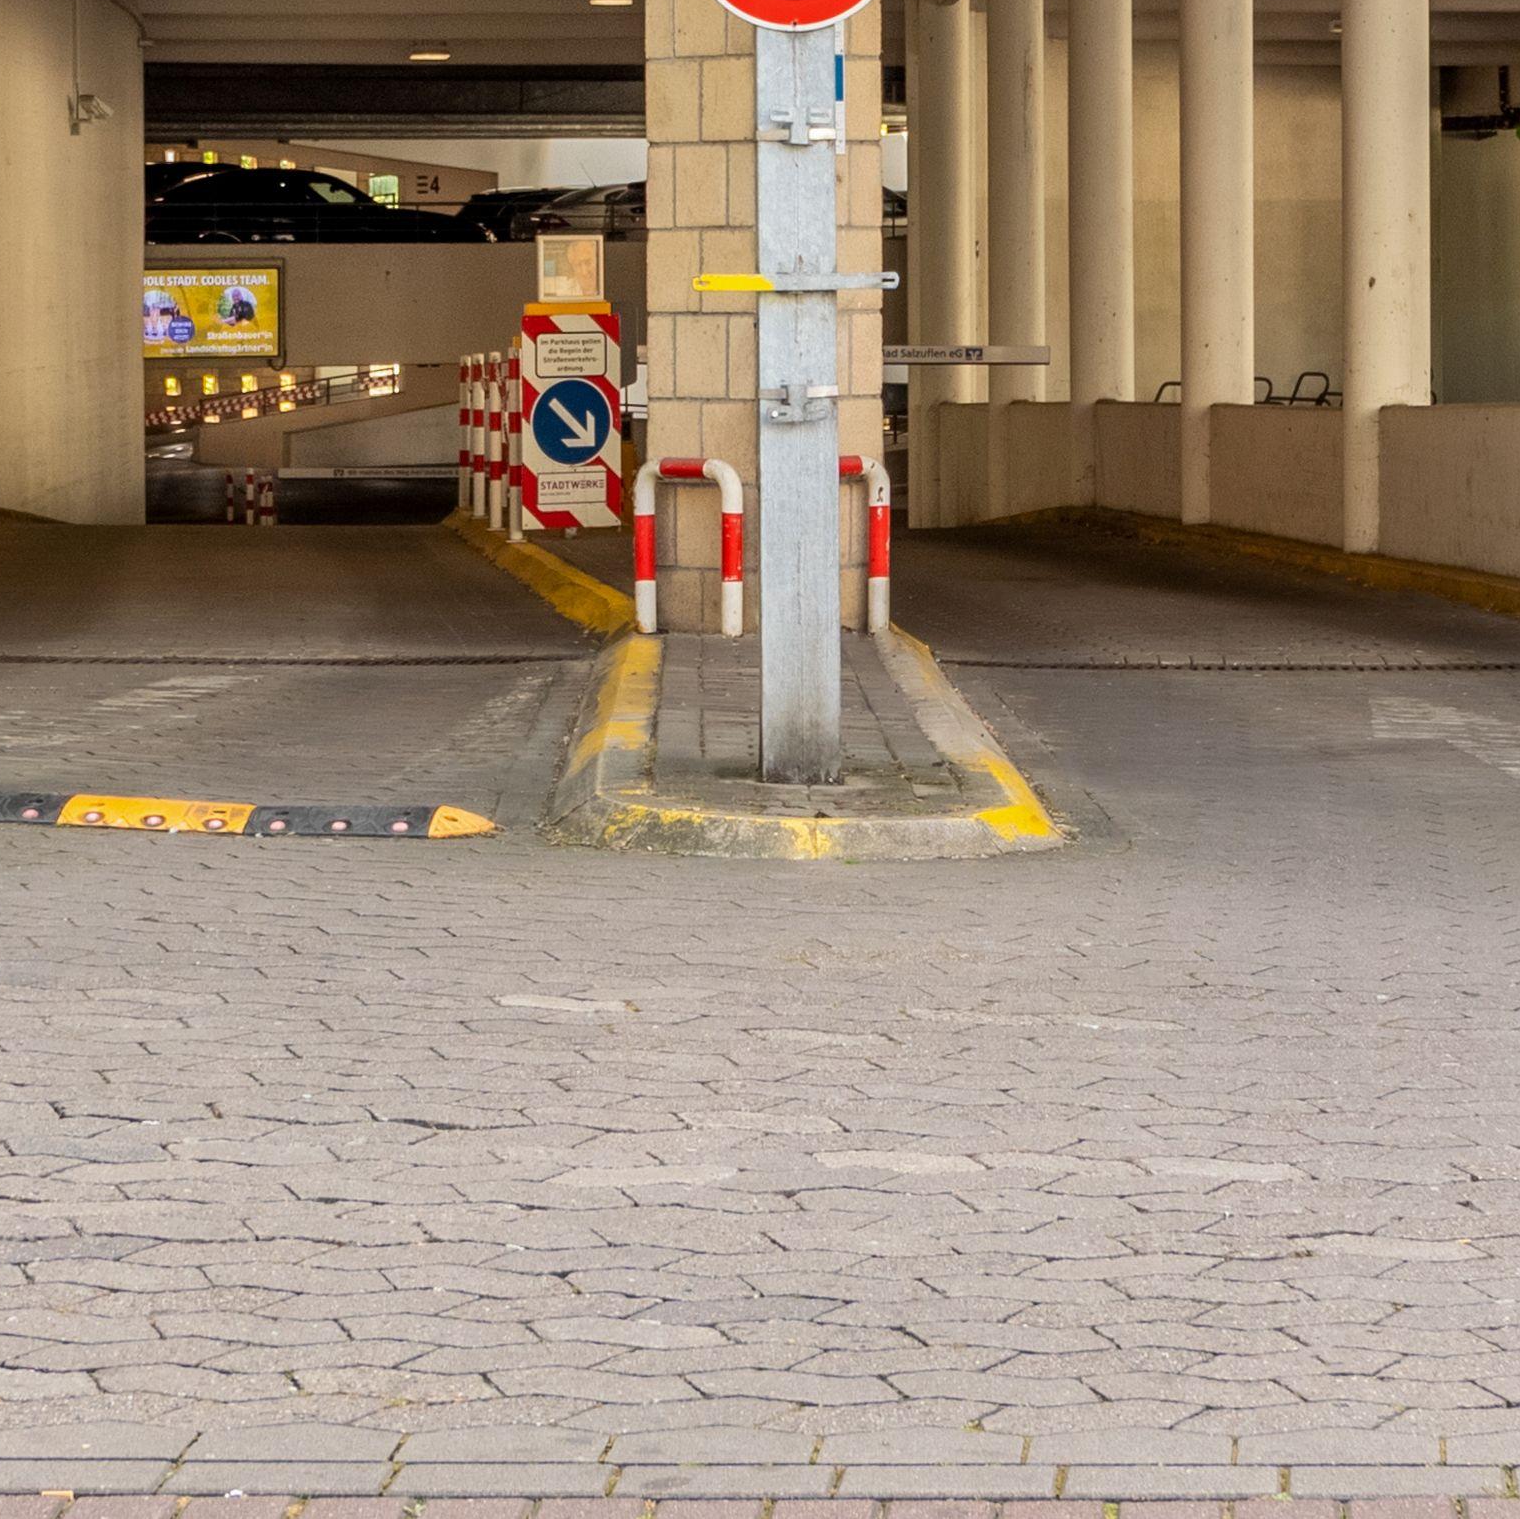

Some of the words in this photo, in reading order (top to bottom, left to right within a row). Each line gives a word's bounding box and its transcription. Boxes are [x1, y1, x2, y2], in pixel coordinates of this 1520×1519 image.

[900, 348, 946, 358] Salzuflen
[949, 349, 963, 358] eG
[541, 479, 604, 490] STADTWERKE
